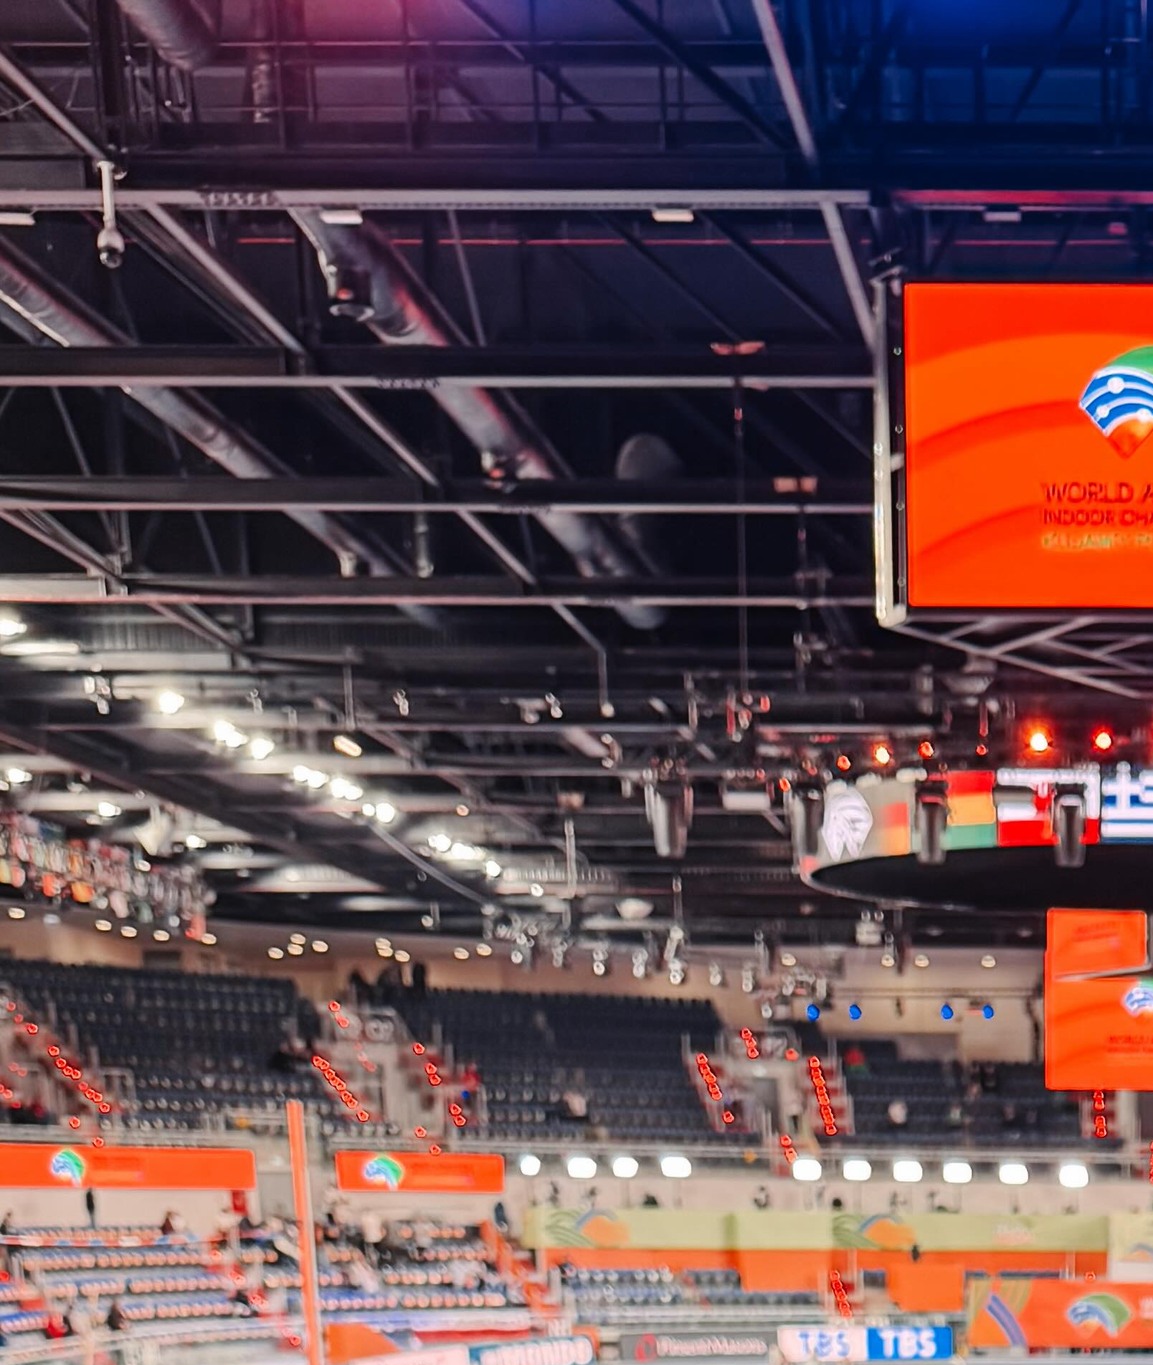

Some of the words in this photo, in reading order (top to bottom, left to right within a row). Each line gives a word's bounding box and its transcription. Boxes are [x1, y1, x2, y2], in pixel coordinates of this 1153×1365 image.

[1041, 482, 1134, 503] WORLD
[1043, 509, 1115, 526] INDOOR
[798, 1330, 850, 1357] TBS
[878, 1329, 937, 1359] TBS
